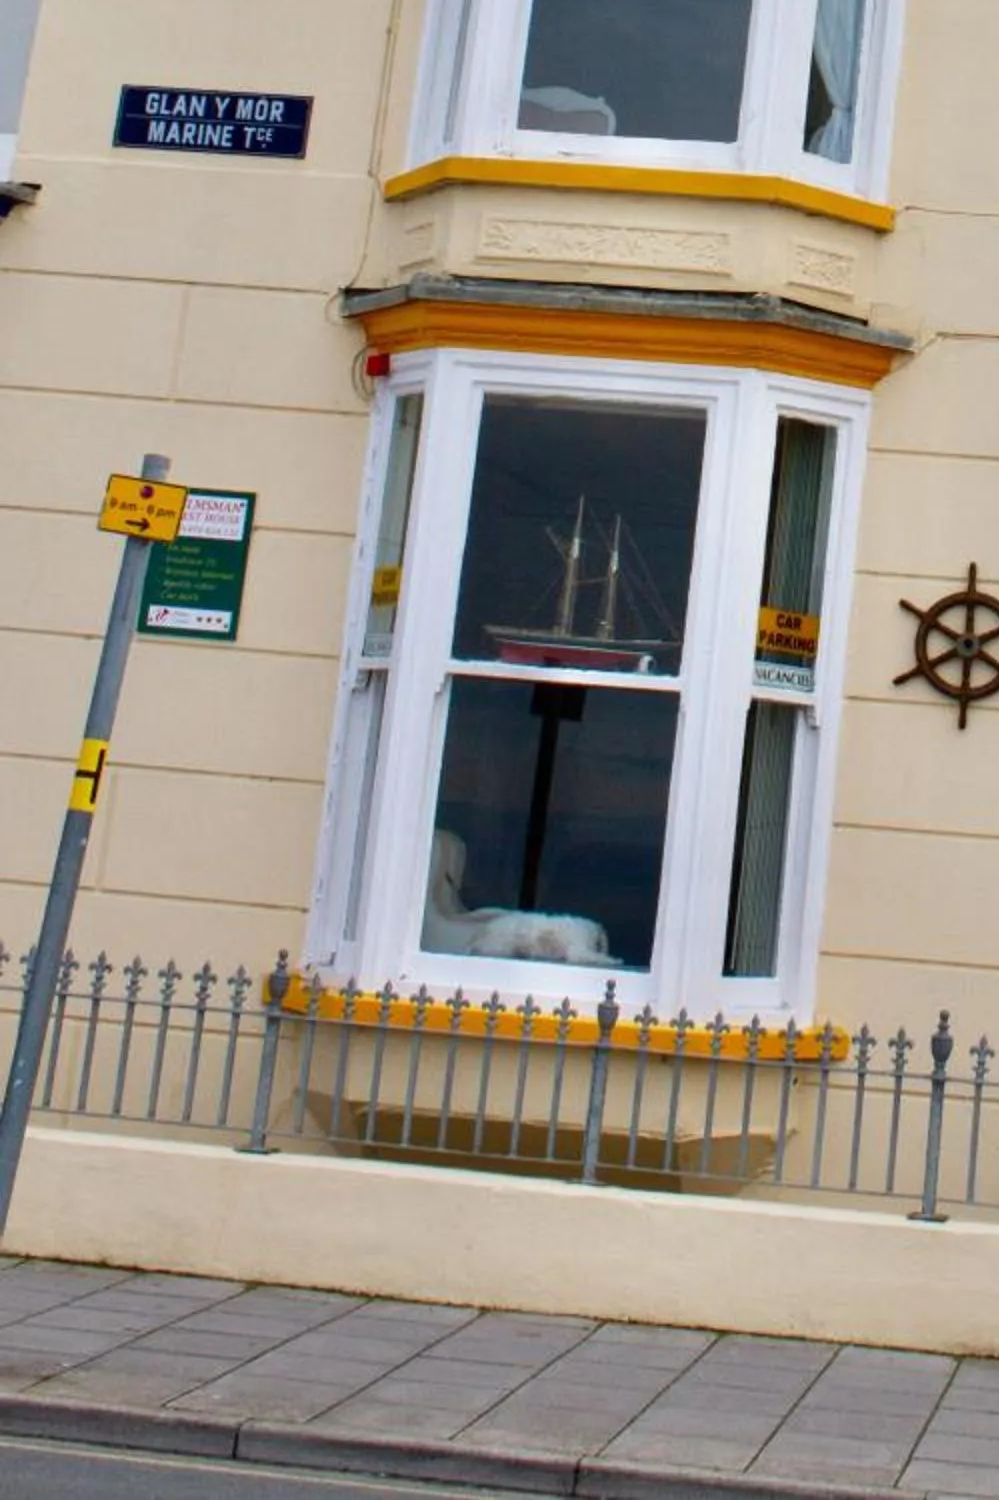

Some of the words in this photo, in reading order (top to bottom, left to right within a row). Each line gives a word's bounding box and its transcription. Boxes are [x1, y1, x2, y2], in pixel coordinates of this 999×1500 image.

[145, 92, 206, 116] GLAN
[214, 97, 230, 118] Y
[147, 121, 234, 147] MARINE
[776, 613, 802, 631] CAR
[758, 629, 815, 654] PARKING
